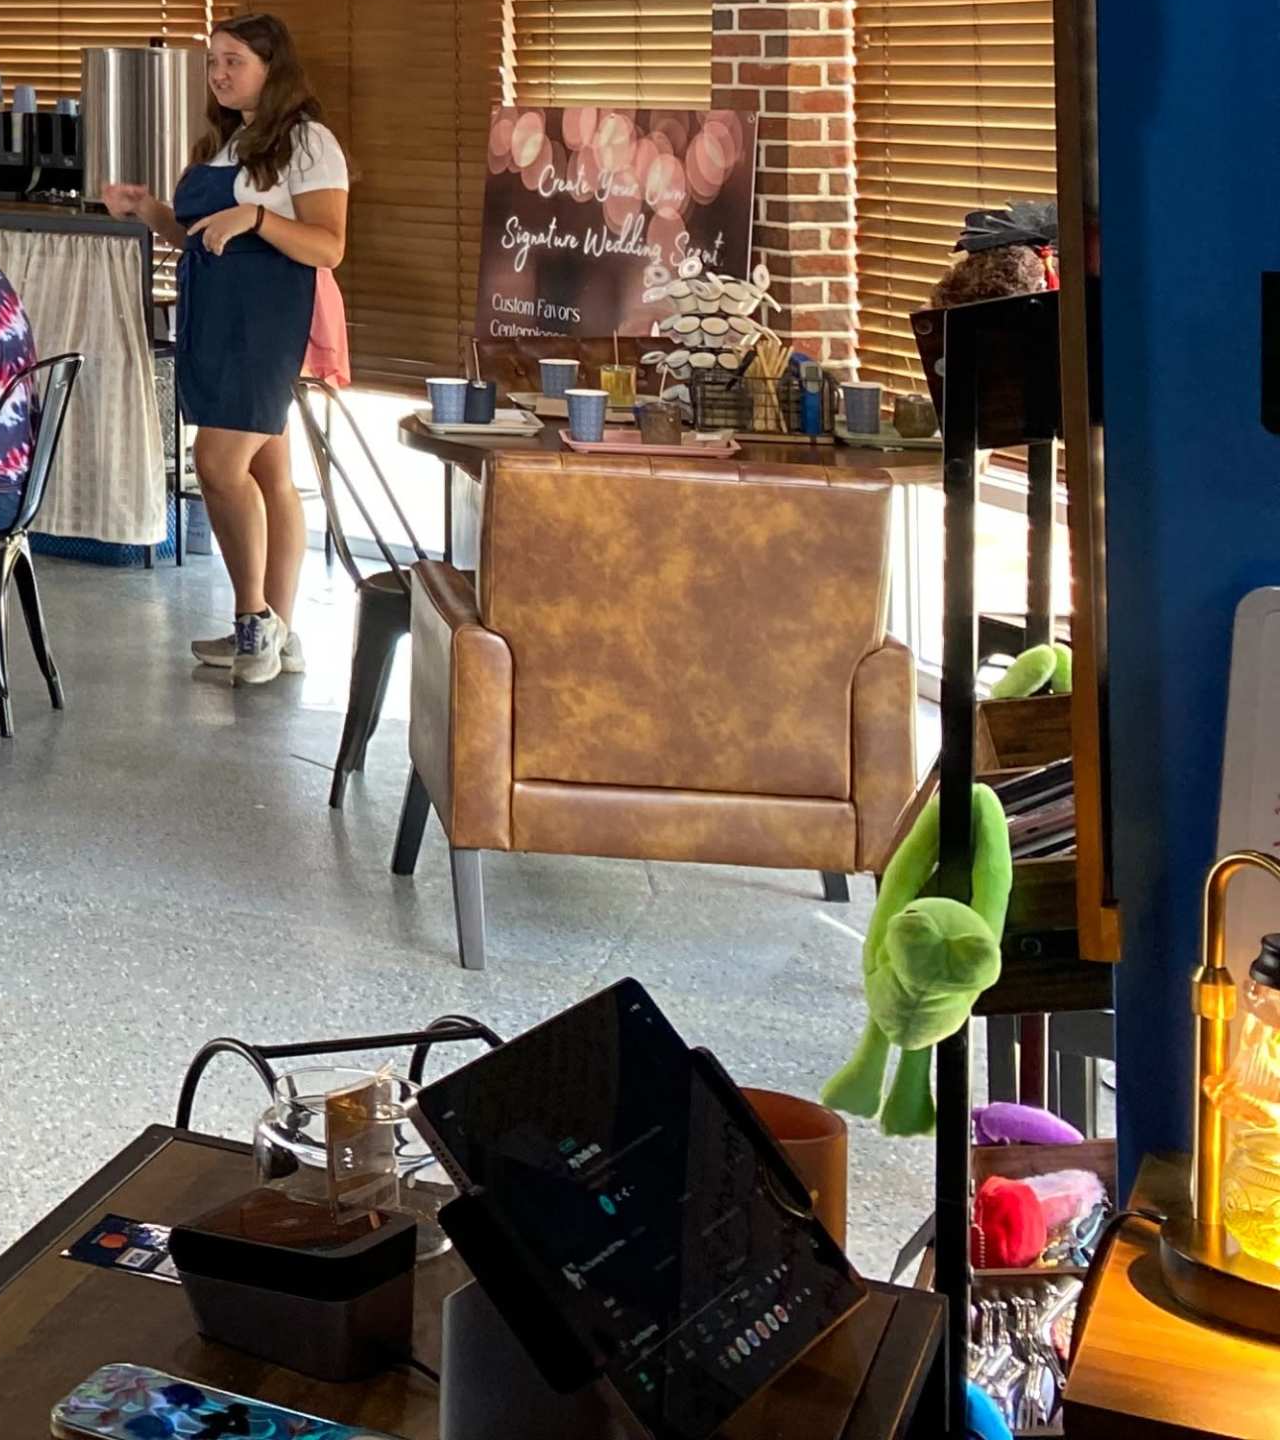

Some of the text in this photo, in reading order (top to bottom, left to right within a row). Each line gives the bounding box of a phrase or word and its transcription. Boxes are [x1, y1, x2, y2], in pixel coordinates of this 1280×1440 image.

[537, 164, 687, 205] Create Your Own
[500, 215, 580, 273] Signature
[583, 212, 663, 265] Wedding
[491, 292, 581, 323] Custom Favors
